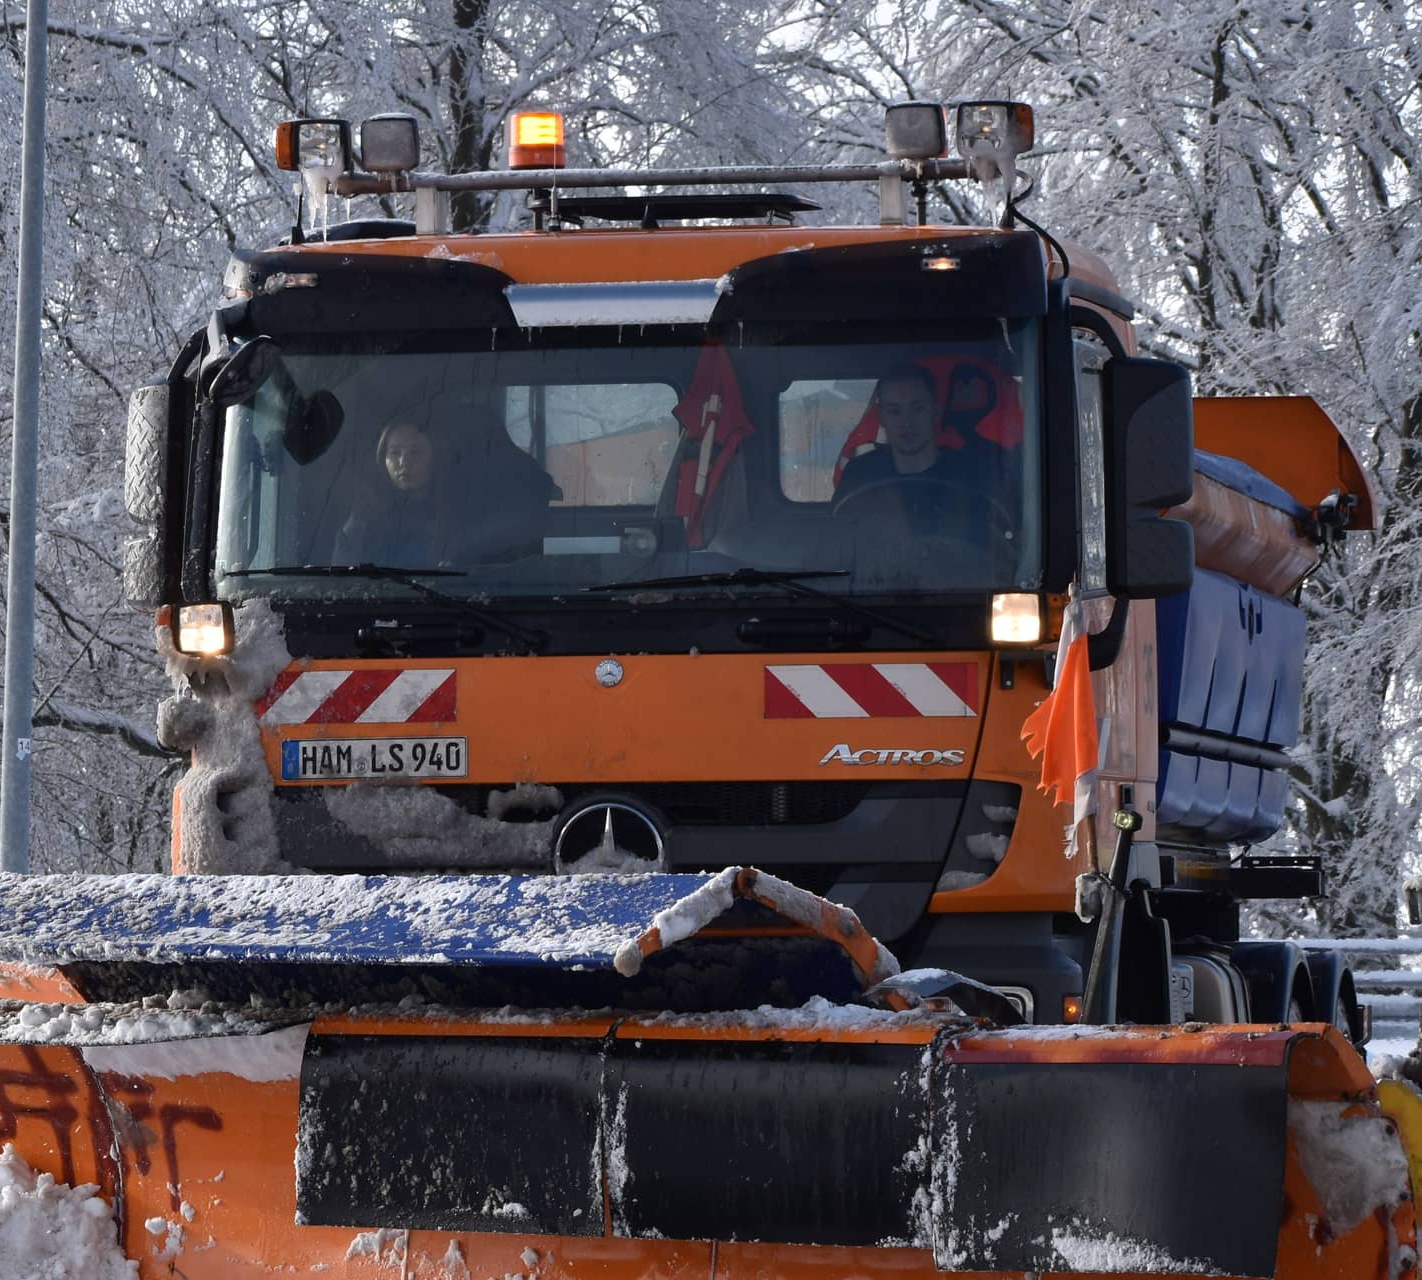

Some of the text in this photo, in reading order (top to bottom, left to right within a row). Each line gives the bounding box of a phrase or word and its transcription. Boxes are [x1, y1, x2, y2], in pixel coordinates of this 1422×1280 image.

[302, 741, 460, 775] HAM LS 940
